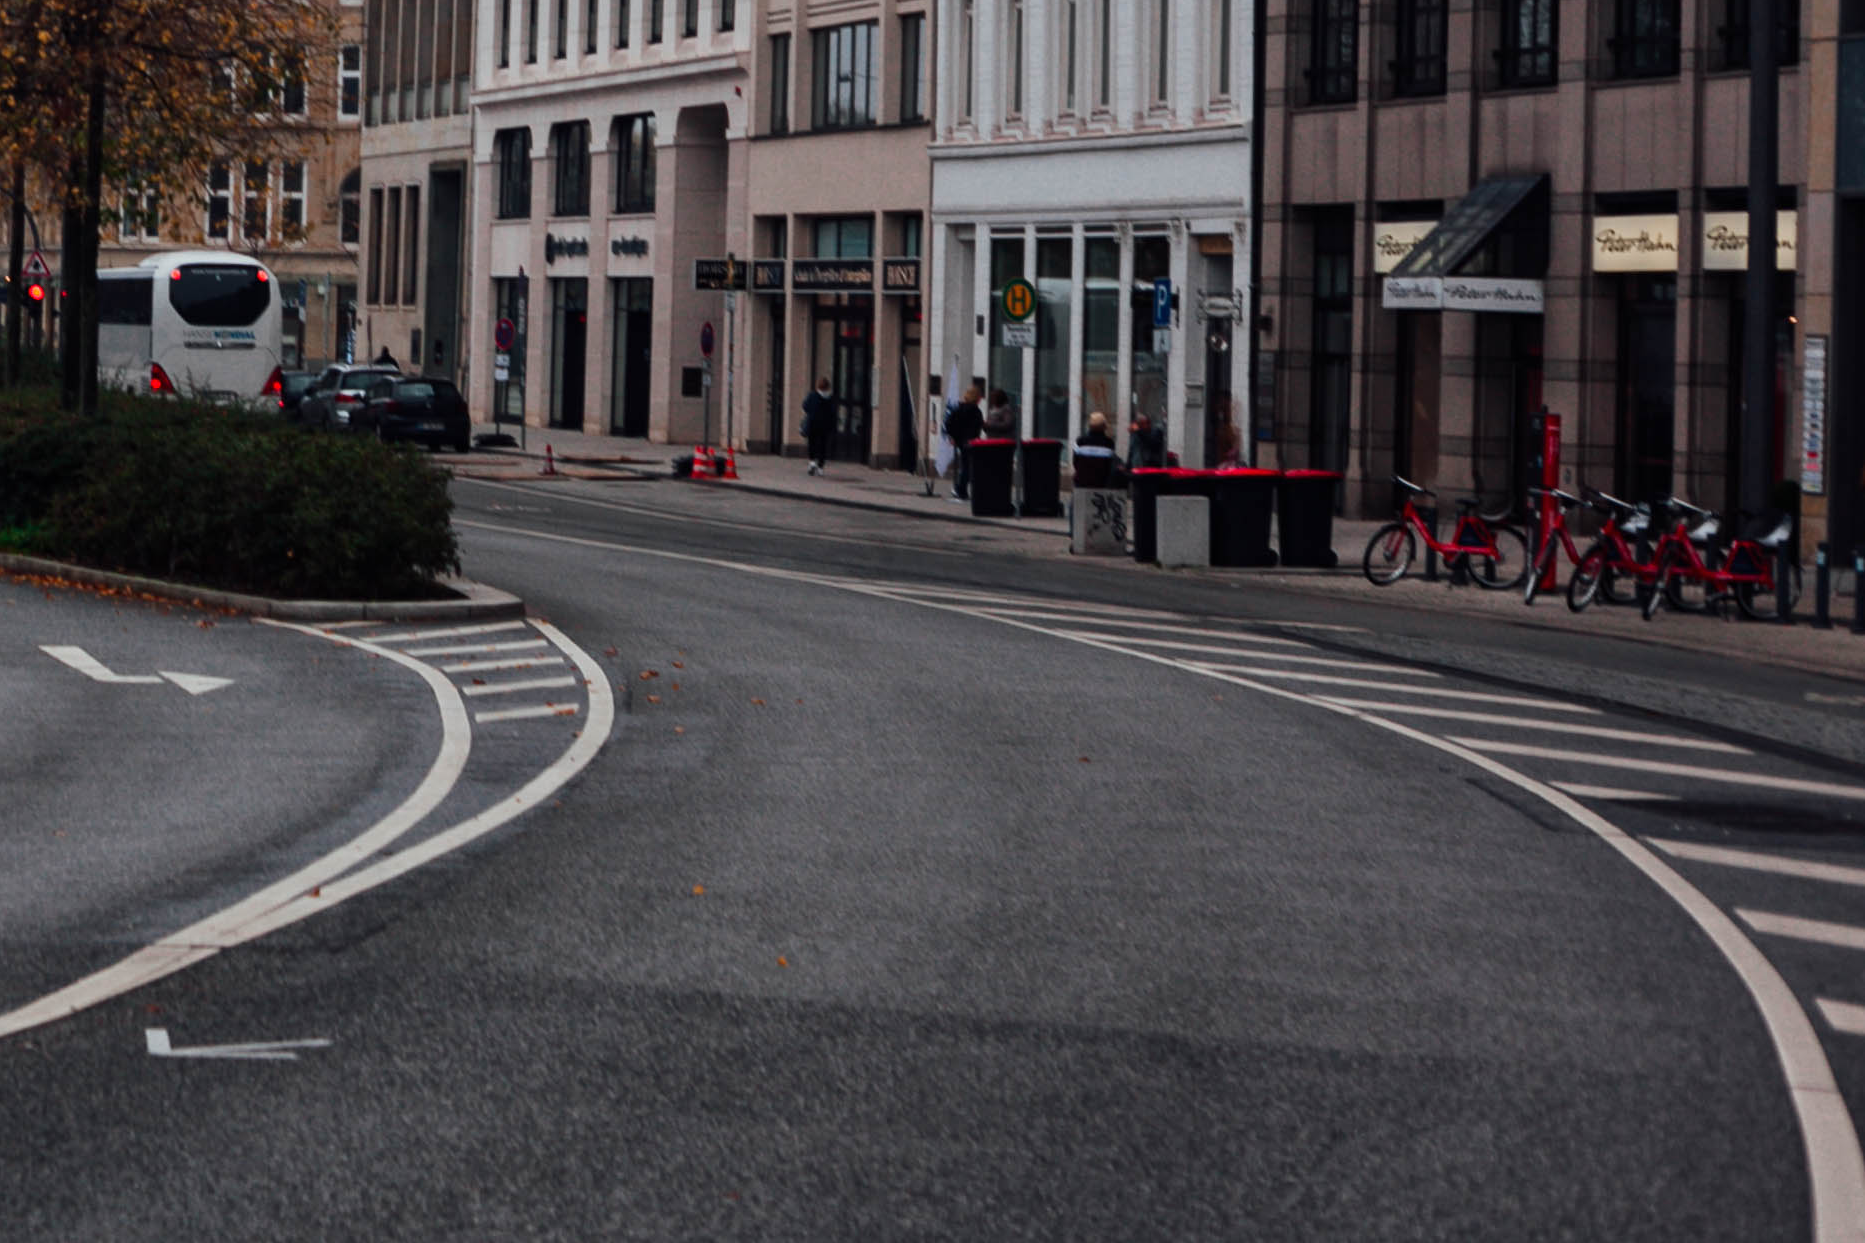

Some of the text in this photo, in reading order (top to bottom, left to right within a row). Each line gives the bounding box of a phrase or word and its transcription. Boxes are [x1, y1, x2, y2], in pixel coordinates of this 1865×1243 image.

[1595, 229, 1677, 252] Peter Hahn
[1011, 286, 1027, 313] H
[1158, 284, 1168, 319] P
[1443, 284, 1491, 300] Peter
